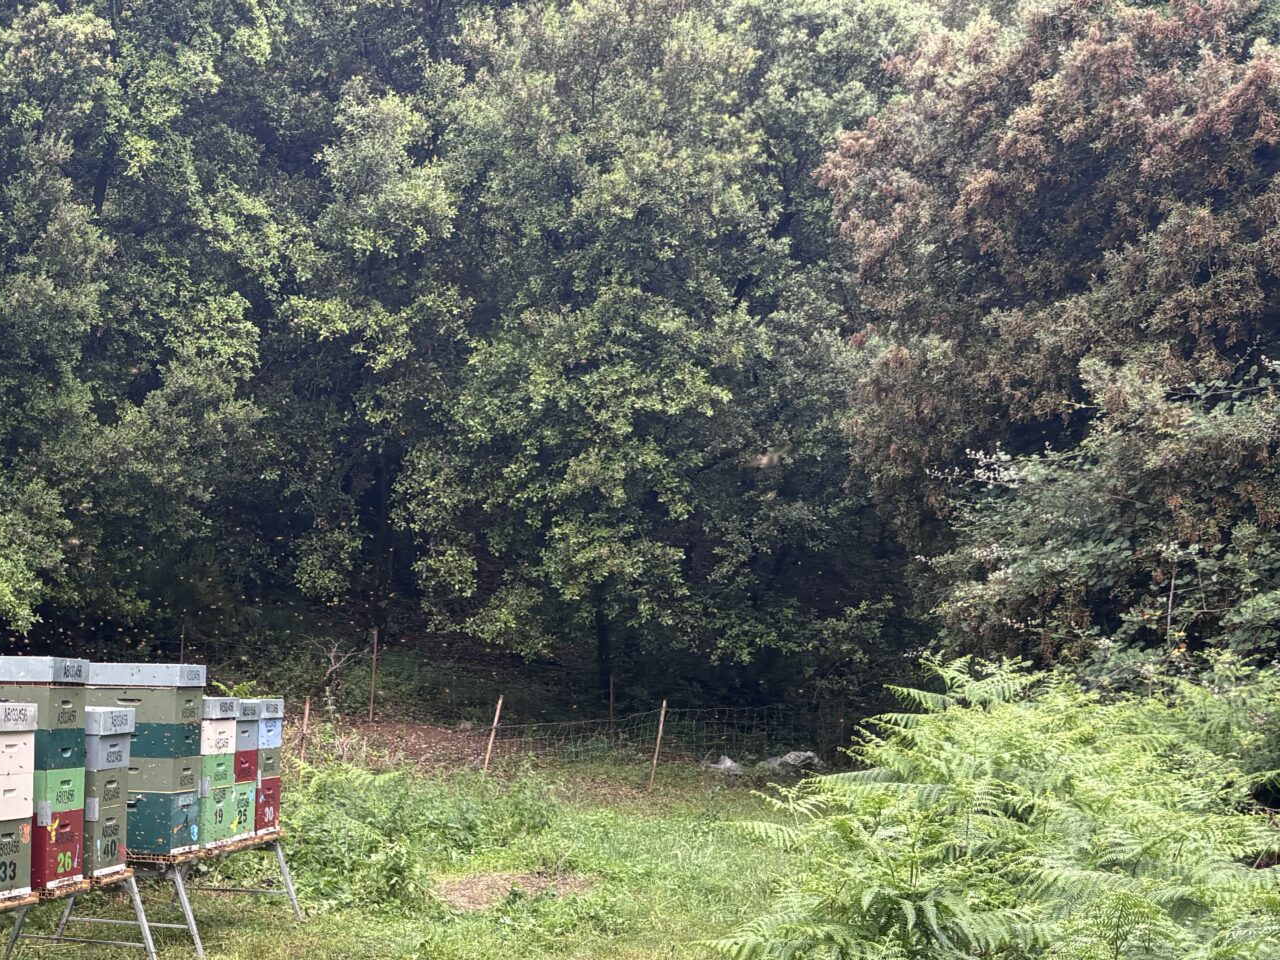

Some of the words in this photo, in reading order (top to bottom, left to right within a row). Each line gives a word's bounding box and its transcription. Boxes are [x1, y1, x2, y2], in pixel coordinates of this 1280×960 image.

[4, 707, 28, 722] A5133456
[215, 808, 224, 825] 19
[238, 809, 248, 825] 25
[103, 839, 117, 858] 40
[57, 851, 72, 873] 26
[0, 860, 17, 883] 33
